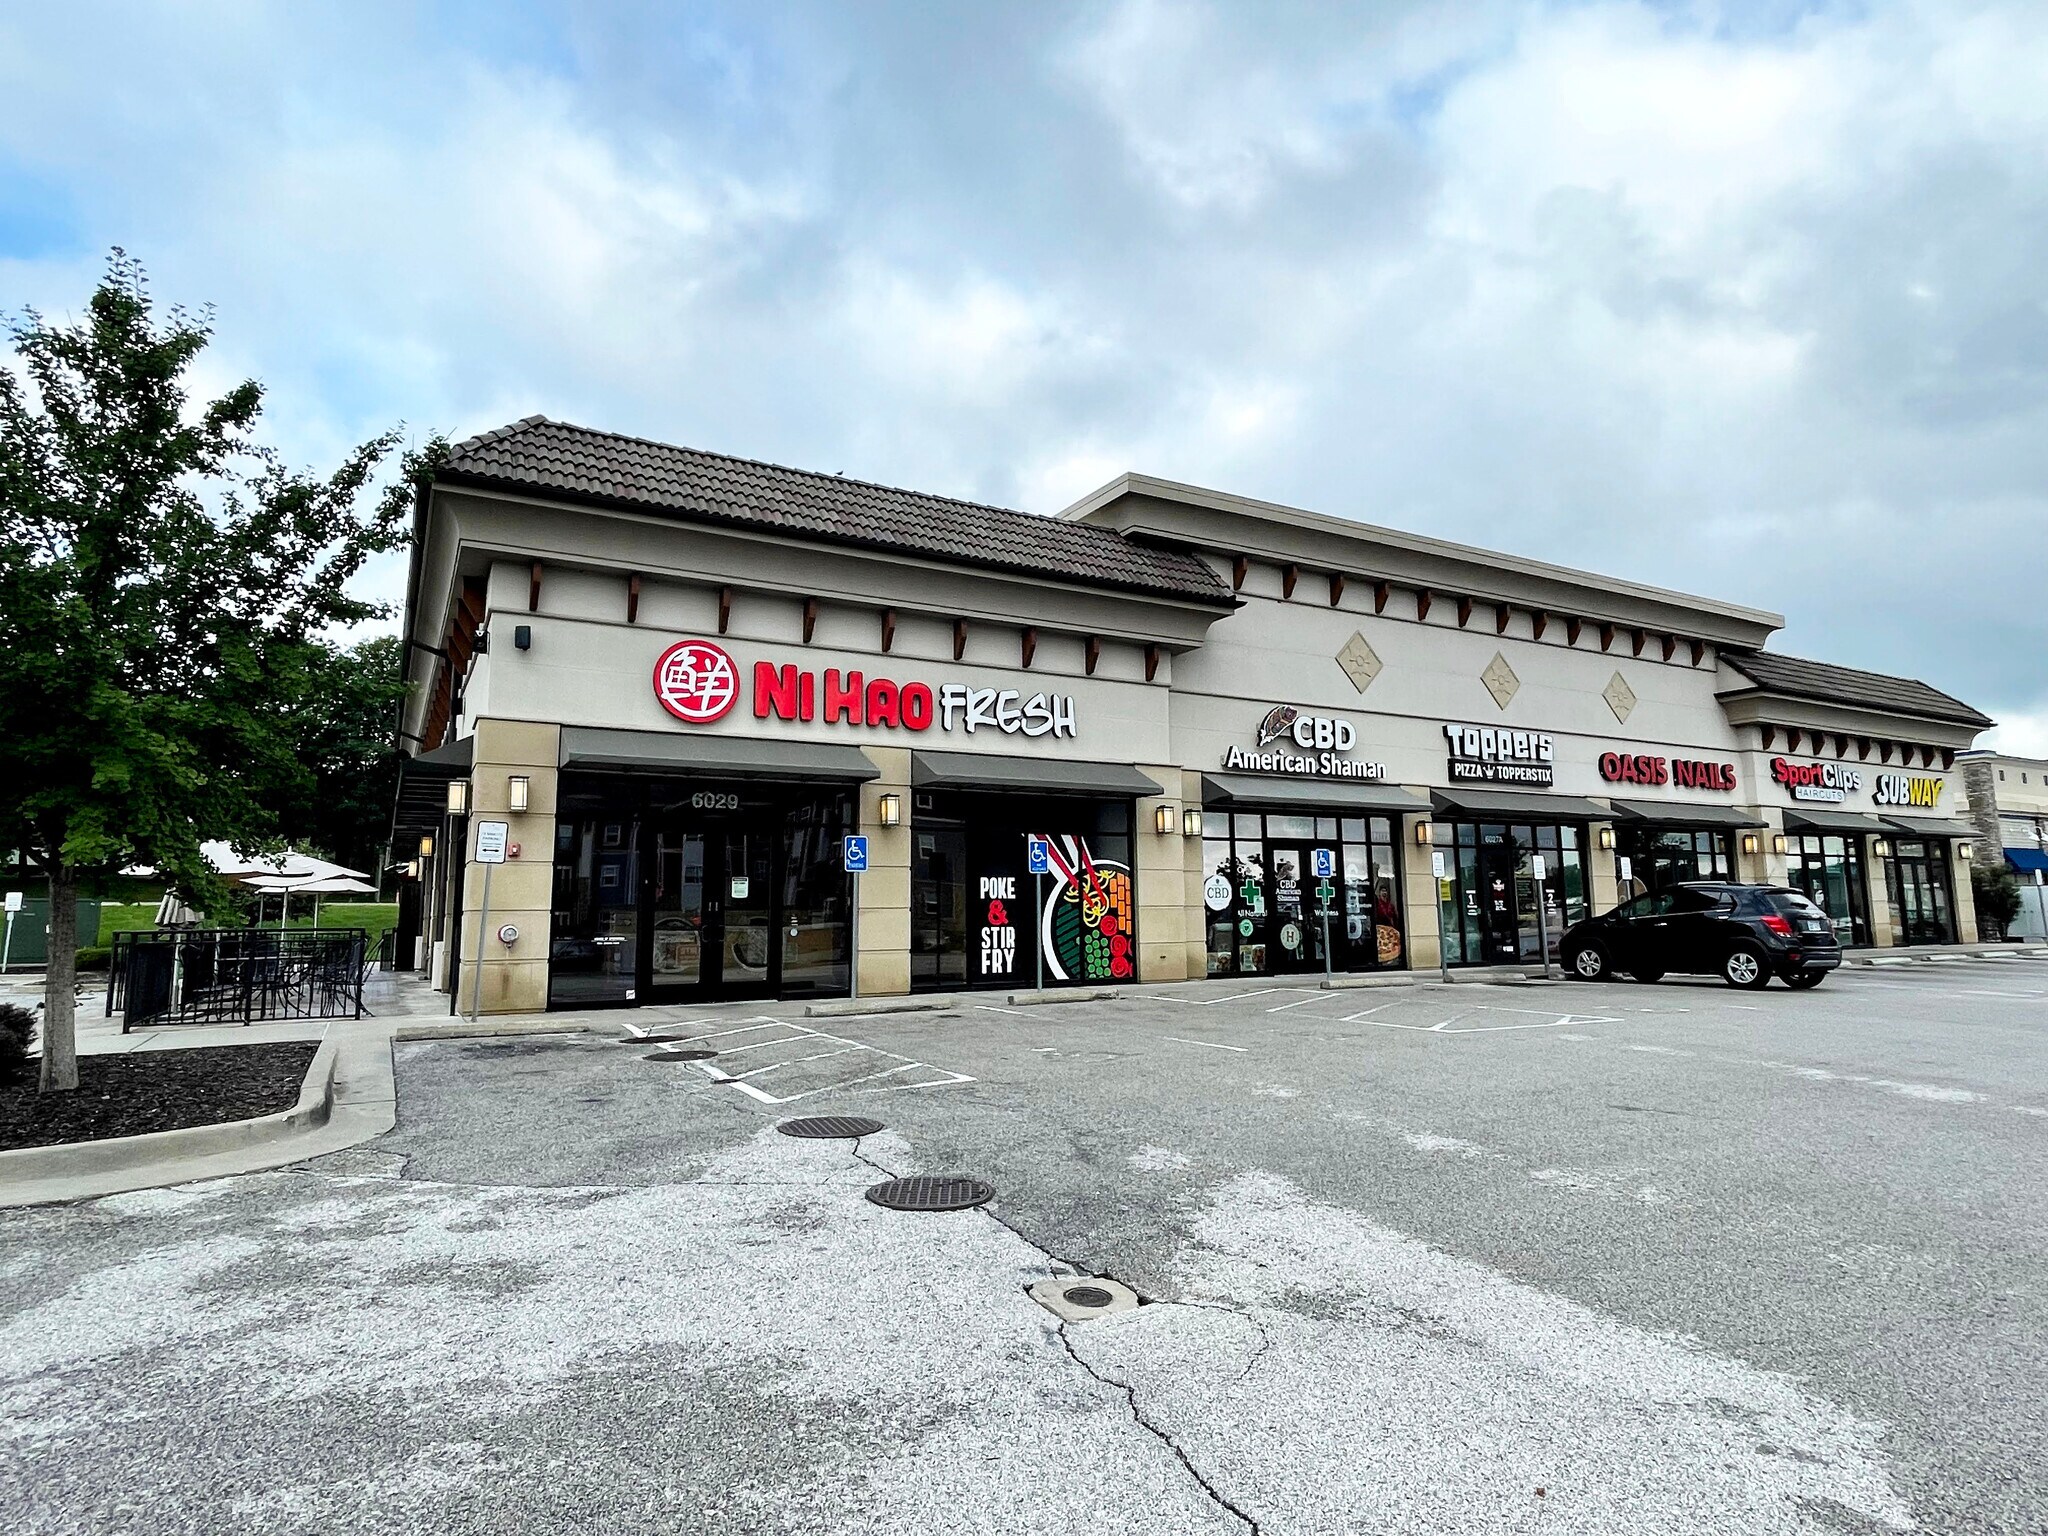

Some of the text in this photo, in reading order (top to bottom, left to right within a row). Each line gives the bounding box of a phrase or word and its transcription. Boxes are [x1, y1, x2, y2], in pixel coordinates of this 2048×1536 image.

[940, 683, 1077, 738] FRESH
[1292, 715, 1357, 751] CBD
[1227, 745, 1387, 779] American Shaman
[1454, 762, 1552, 782] PIZZA TOPPERSTIX
[1600, 752, 1737, 790] OASIS NAILS
[691, 792, 739, 809] 6029
[1796, 788, 1844, 801] HAIRCUTS
[1875, 774, 1946, 807] SUBWAY
[980, 876, 1016, 899] POKE
[1207, 886, 1230, 899] CBD
[1279, 879, 1297, 889] CBD
[1548, 893, 1554, 904] 2
[988, 900, 1009, 925] &
[981, 926, 1016, 949] STIR
[1286, 930, 1295, 943] H
[981, 948, 1016, 974] FRY
